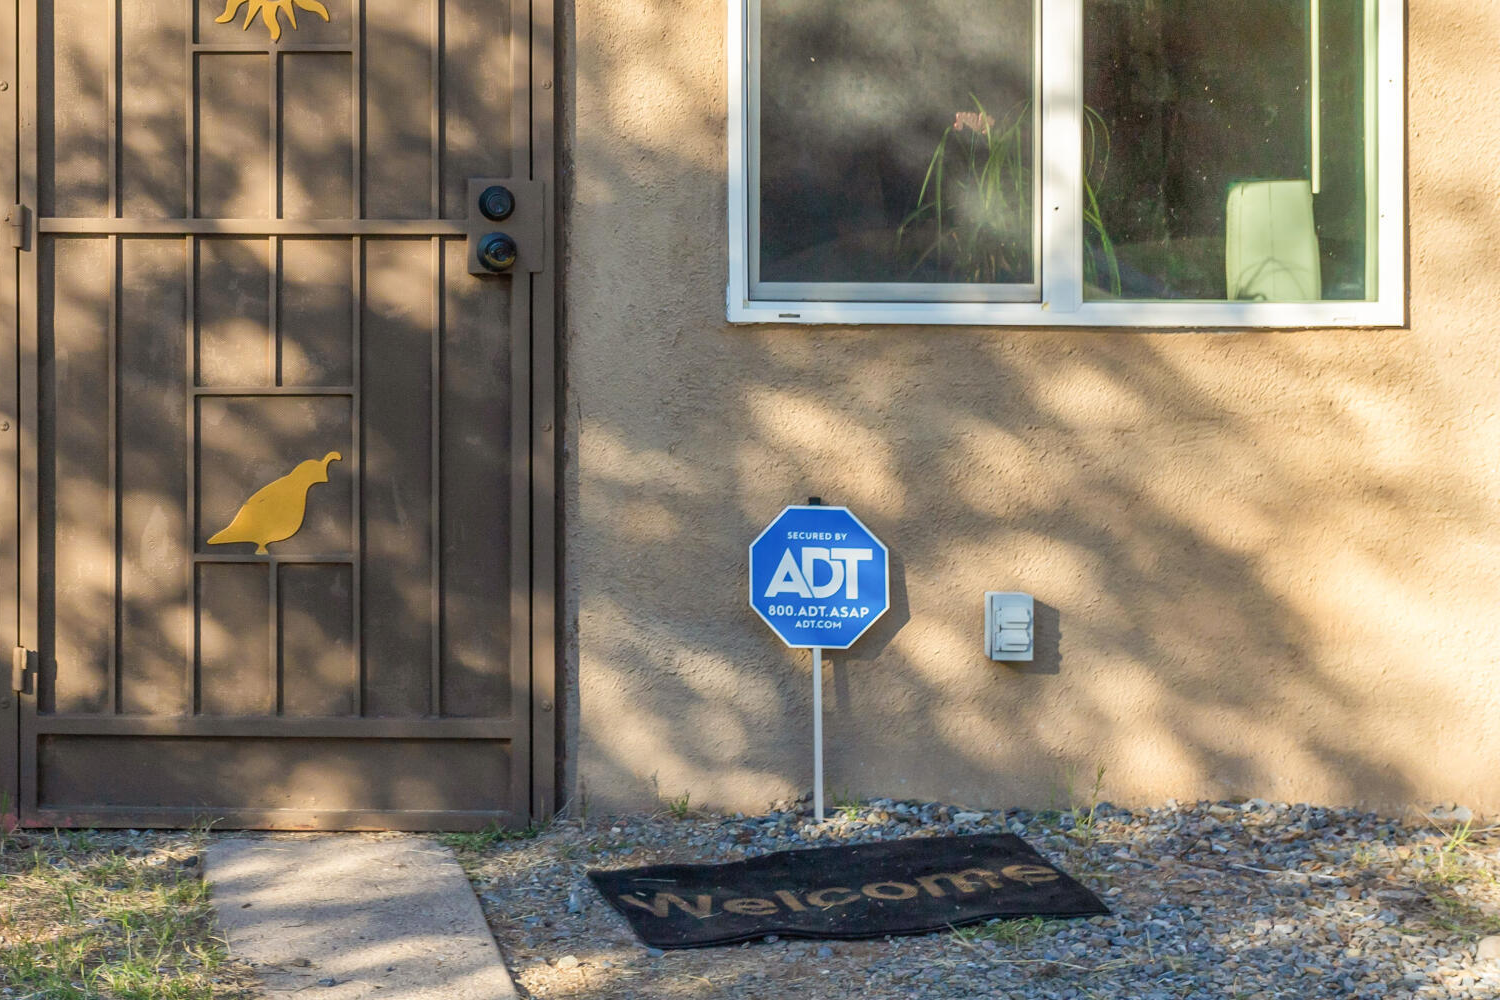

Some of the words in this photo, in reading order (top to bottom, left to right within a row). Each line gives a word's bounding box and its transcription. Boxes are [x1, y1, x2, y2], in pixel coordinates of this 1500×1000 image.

[787, 531, 832, 541] SECURED
[835, 532, 848, 541] BY
[764, 547, 873, 600] ADT
[768, 605, 870, 618] 800.ADT.ASAP
[795, 620, 842, 629] ADT.COM
[618, 864, 1061, 918] Welcome
